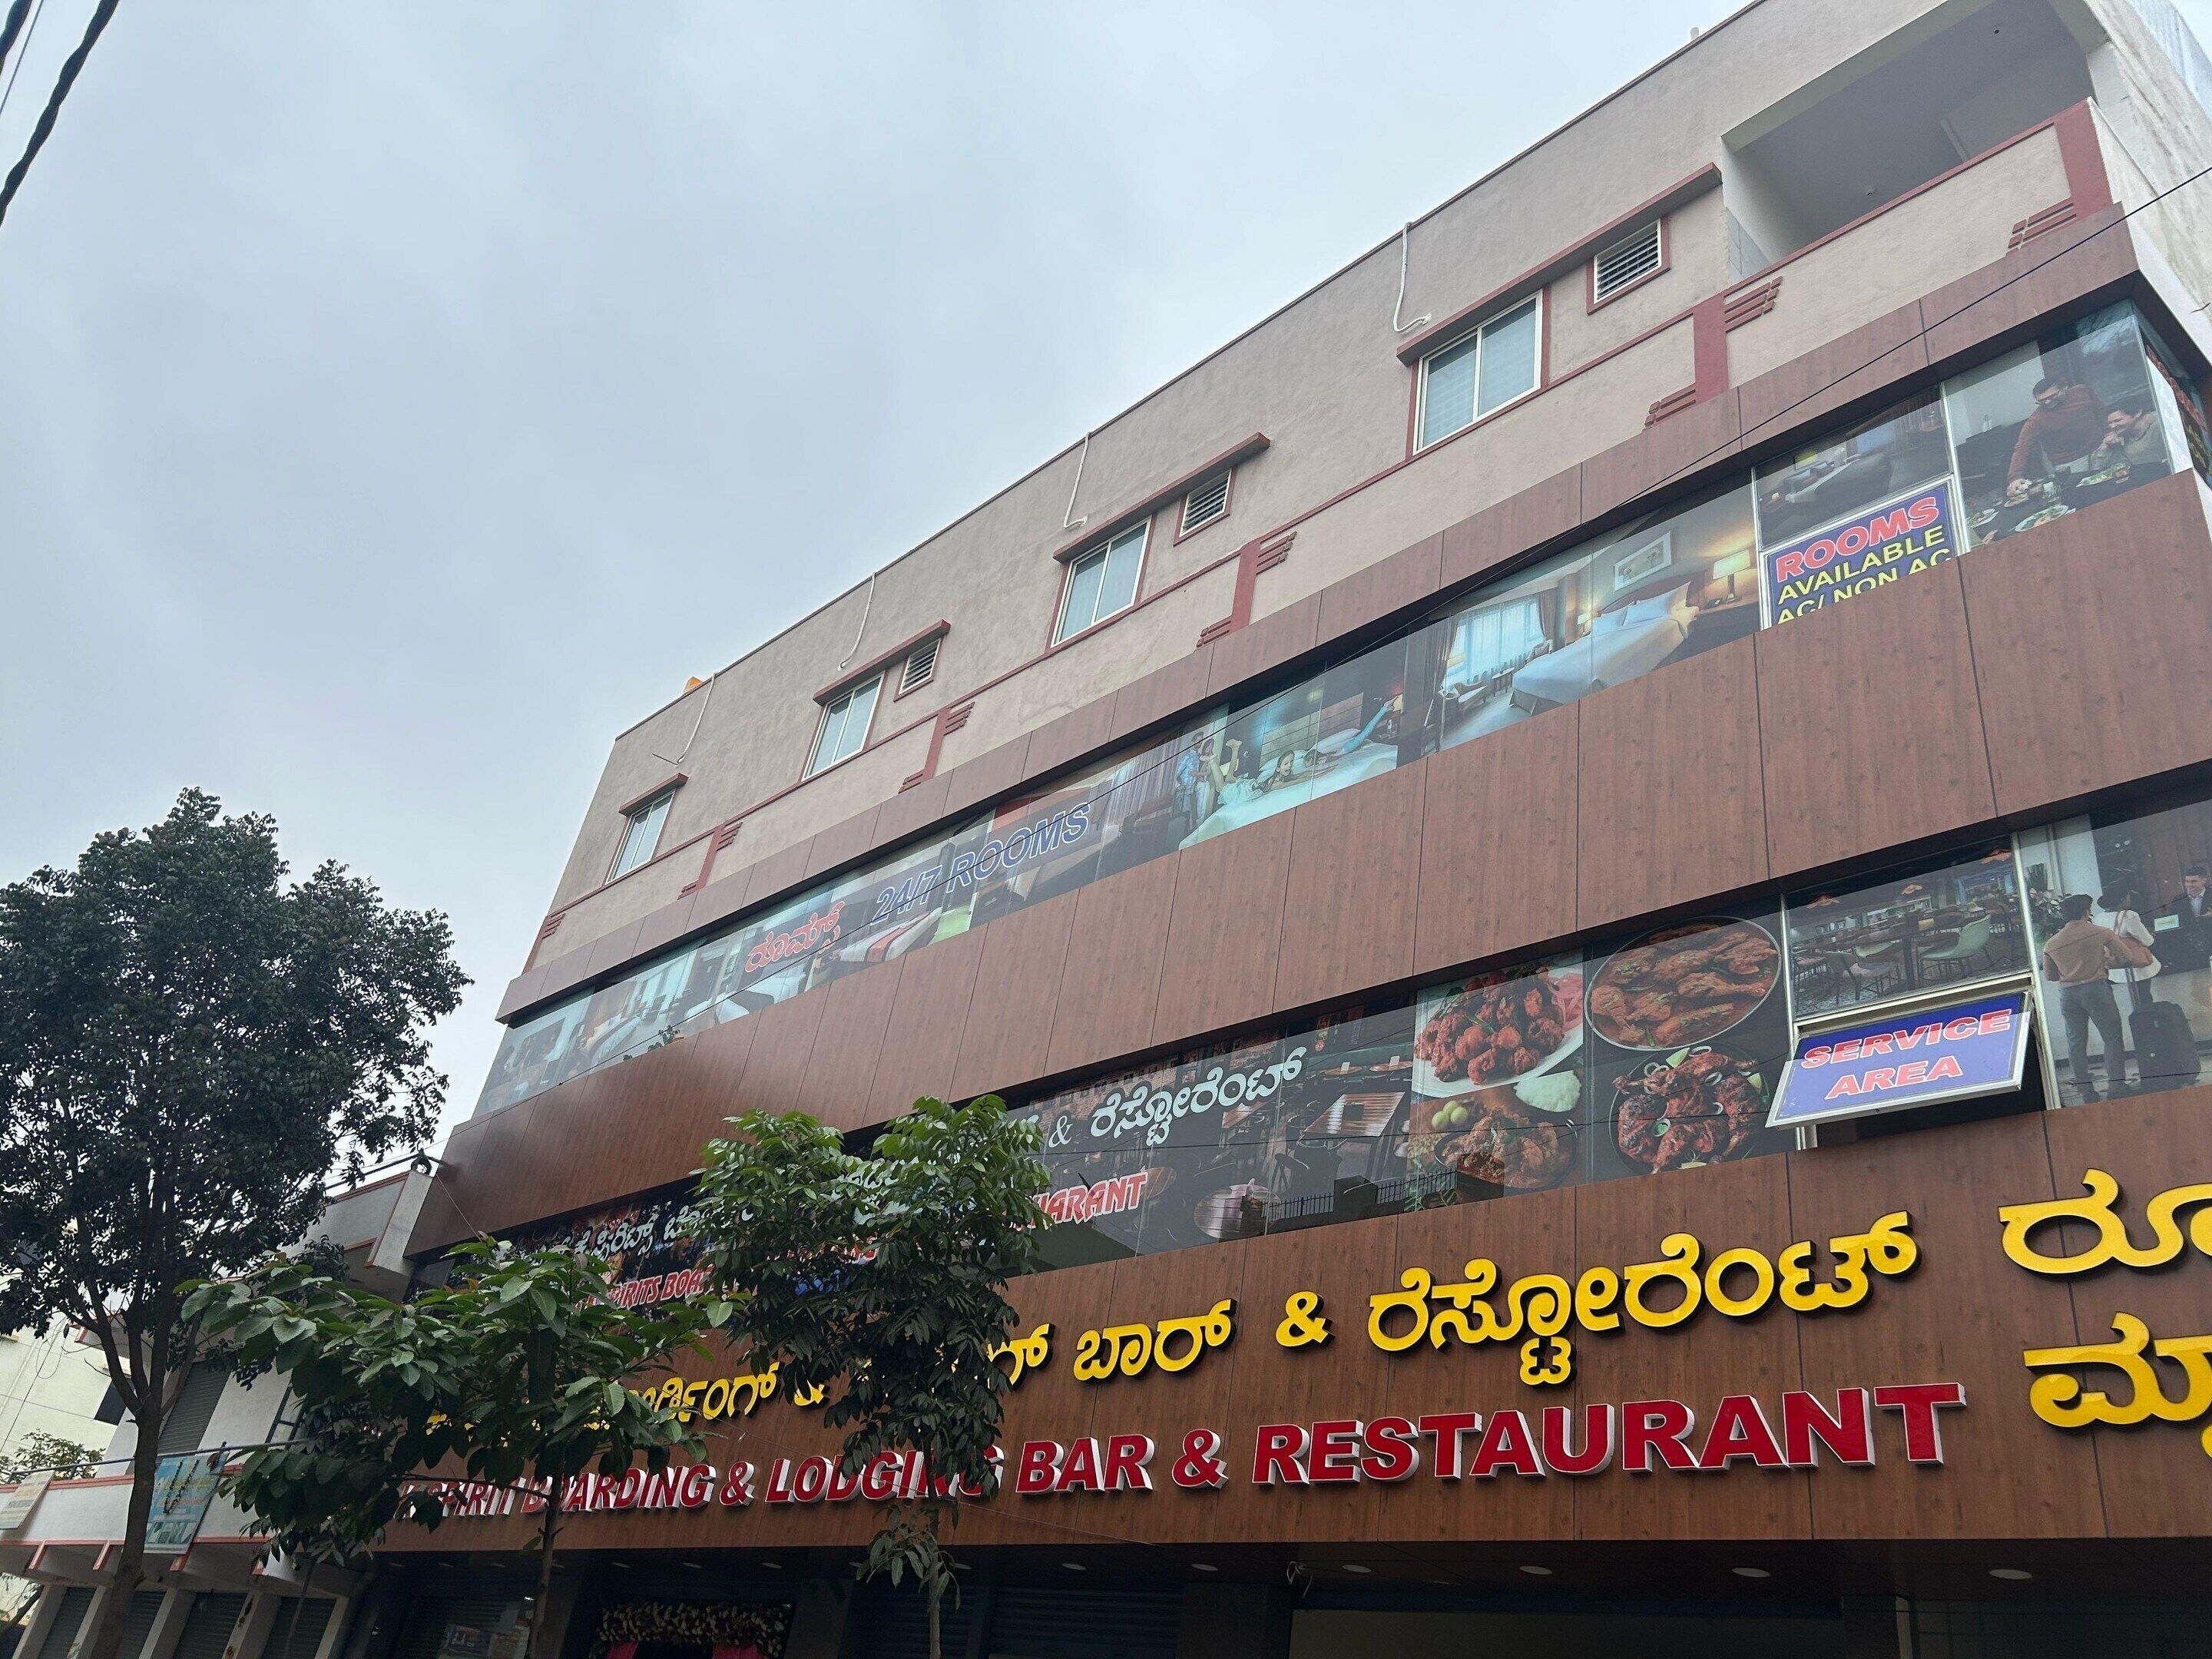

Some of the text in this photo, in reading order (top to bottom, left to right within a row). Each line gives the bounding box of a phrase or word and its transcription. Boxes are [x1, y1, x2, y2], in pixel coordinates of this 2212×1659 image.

[1776, 497, 1939, 583] ROOMS
[1778, 525, 1945, 604] AVAILABLE
[745, 802, 1091, 972] ರೂಮ್ಸ್ 24/7 ROOMS
[1800, 1008, 2012, 1068] SERVICE
[1824, 1055, 1963, 1100] AREA
[1048, 1115, 1073, 1148] &
[1091, 1046, 1307, 1147] ರೆಸ್ಟೋರೆಂಟ್
[1074, 1298, 1233, 1382] ಬಾರ್
[1275, 1290, 1333, 1348] &
[1368, 1210, 1920, 1386] ರೆಸ್ಟೋರೆಂಟ್
[719, 1461, 755, 1507] &
[1015, 1435, 1155, 1495] BAR
[1172, 1429, 1229, 1488] &
[1252, 1382, 1966, 1485] RESTAURANT
